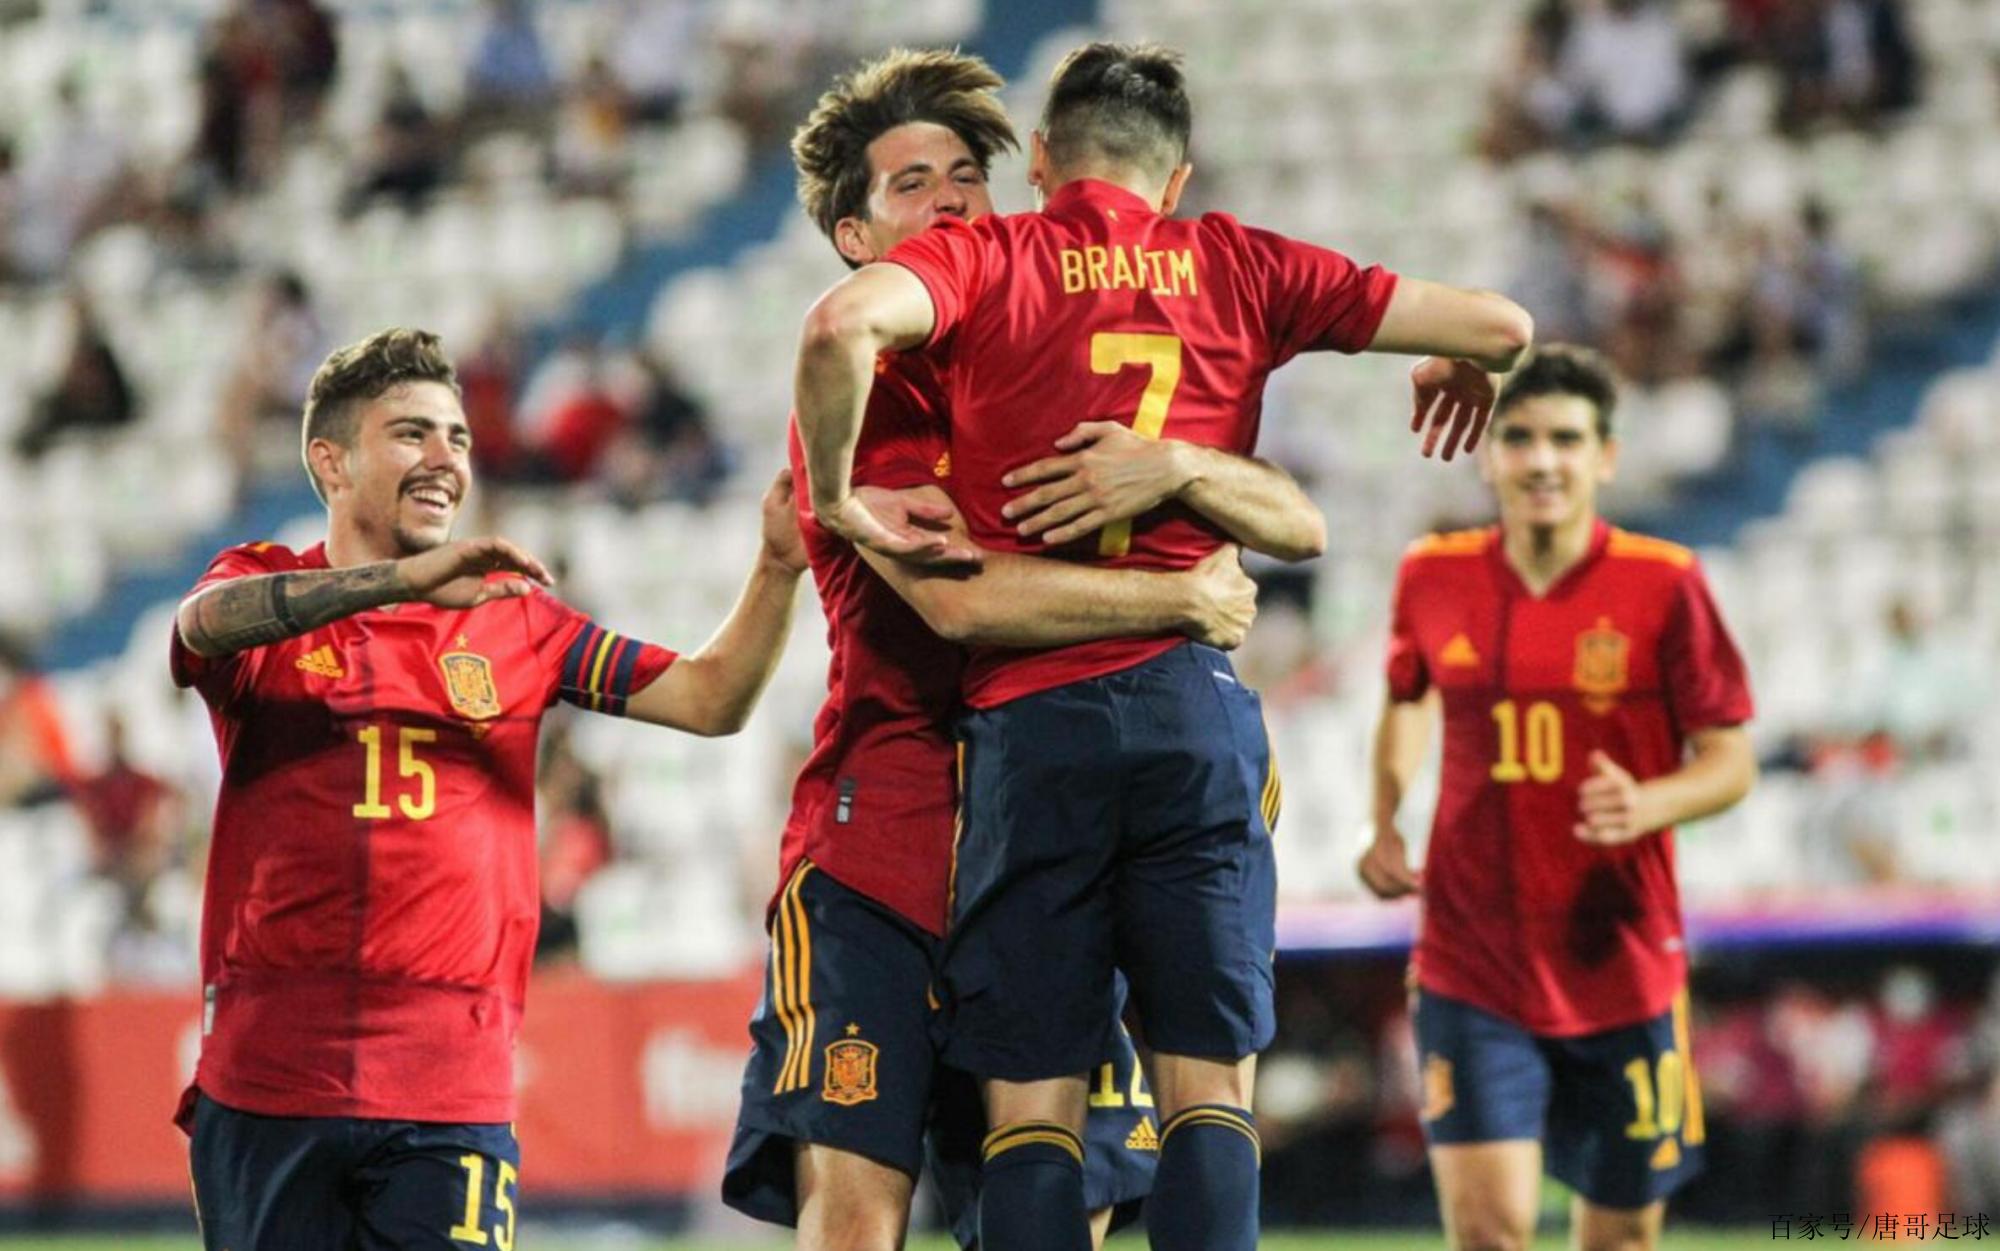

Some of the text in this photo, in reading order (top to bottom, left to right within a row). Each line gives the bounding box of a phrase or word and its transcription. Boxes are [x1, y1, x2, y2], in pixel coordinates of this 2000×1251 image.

[1091, 332, 1182, 557] 7
[353, 726, 437, 820] 15
[1490, 700, 1564, 782] 10
[1624, 1050, 1682, 1138] 10
[450, 1153, 517, 1251] 15
